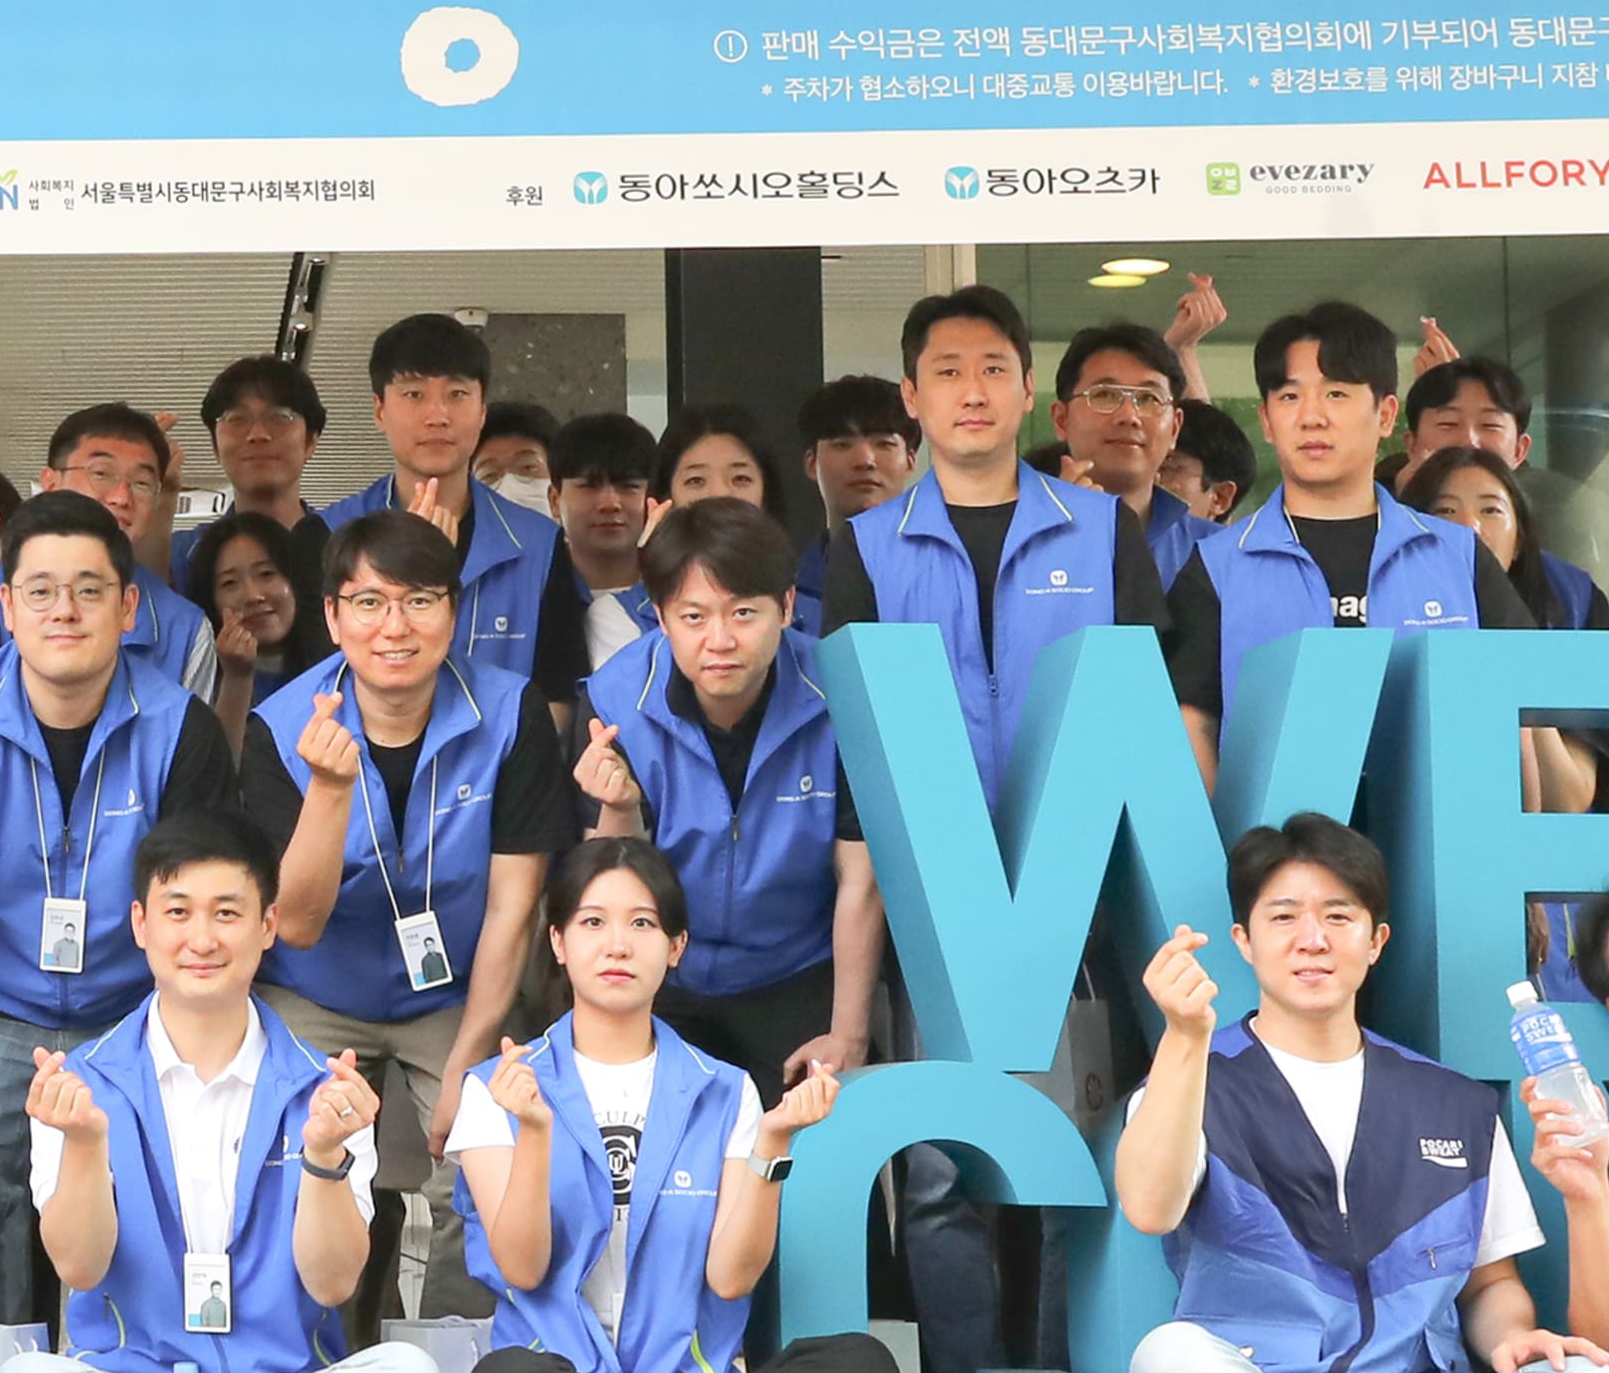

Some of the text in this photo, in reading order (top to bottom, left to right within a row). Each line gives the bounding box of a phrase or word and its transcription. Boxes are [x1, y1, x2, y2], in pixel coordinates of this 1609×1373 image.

[763, 30, 819, 60] 판매
[829, 29, 944, 59] 수익금은
[954, 27, 1010, 56] 전액
[1021, 21, 1371, 56] 동대문구사회복지협의회에
[1382, 19, 1498, 49] 기부되어
[784, 77, 853, 102] 주차가
[860, 74, 974, 100] 협소하오니
[983, 73, 1075, 98] 대중교통
[1083, 70, 1227, 96] 이용바랍니다.
[1272, 67, 1387, 93] 환경보호를
[1397, 66, 1441, 91] 위해
[1450, 64, 1542, 90] 장바구니
[1552, 63, 1598, 87] 지참
[29, 180, 73, 191] 사회복지
[620, 171, 899, 201] 동아쏘시오홀딩스
[987, 167, 1160, 196] 동아오츠카
[1251, 165, 1369, 183] evezary
[82, 179, 374, 204] 서울특별시동대문구사회복지협의회
[507, 187, 542, 205] 후원
